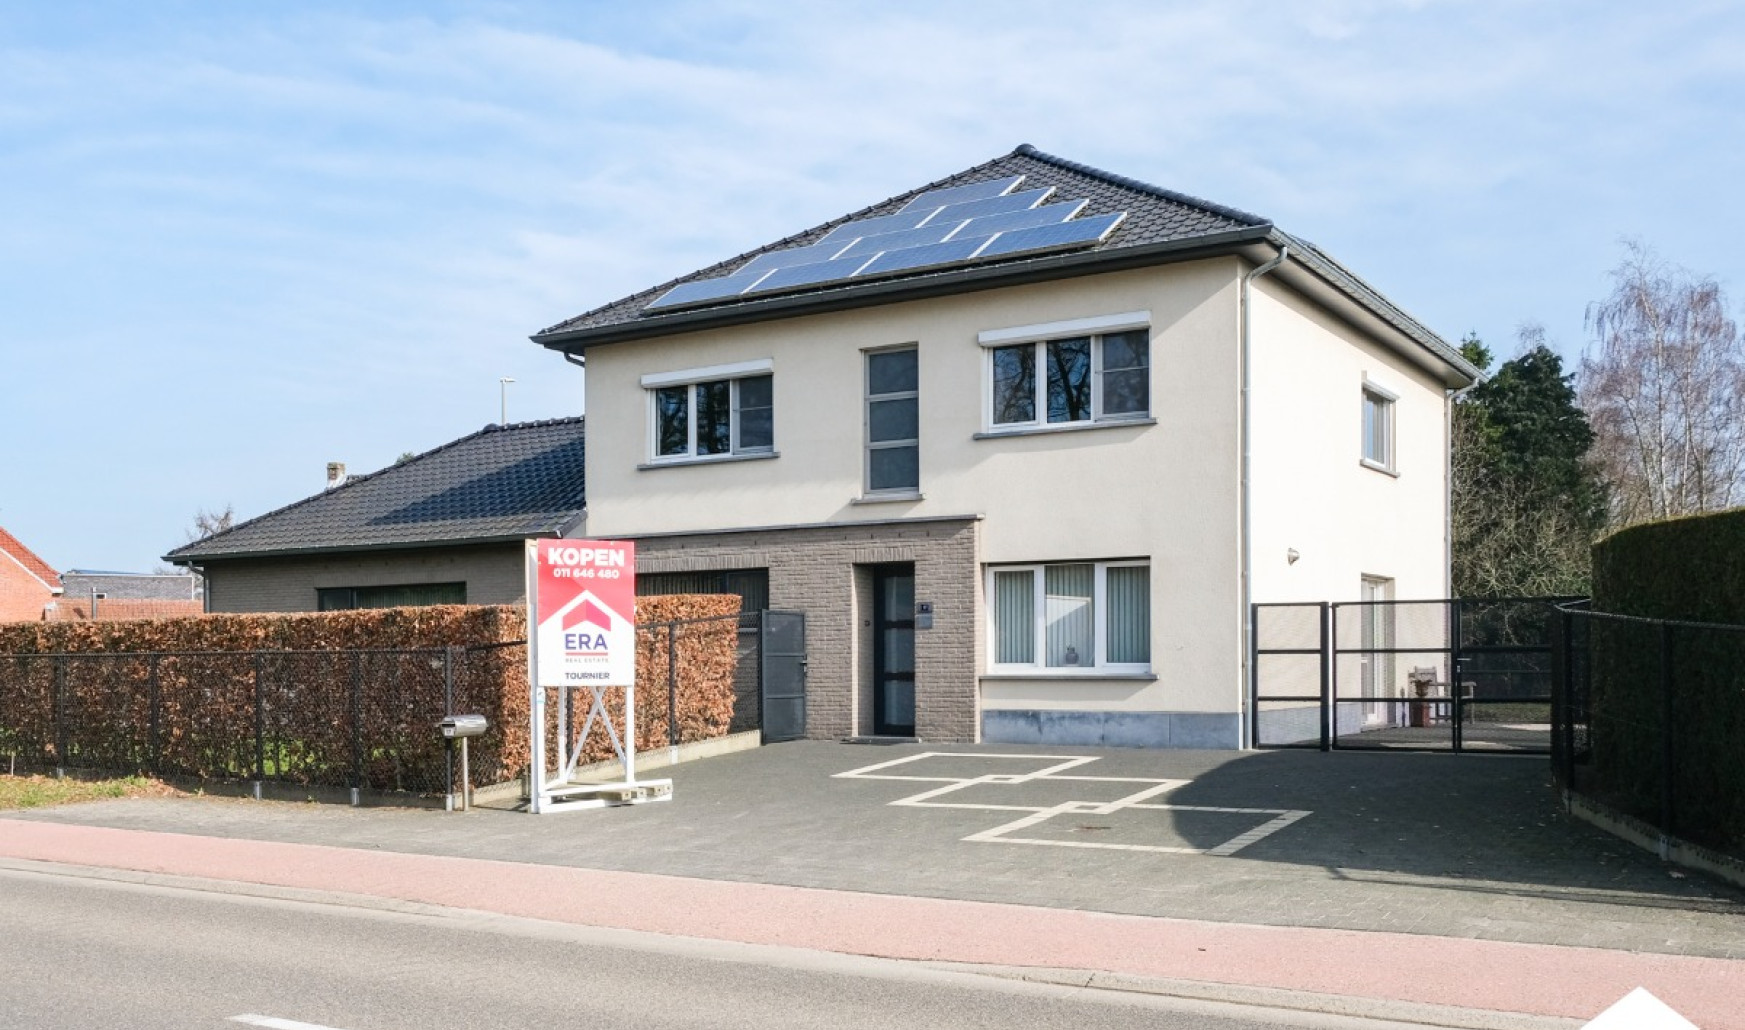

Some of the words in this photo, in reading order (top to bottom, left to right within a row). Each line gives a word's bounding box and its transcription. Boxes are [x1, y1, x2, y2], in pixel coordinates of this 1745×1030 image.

[547, 547, 625, 567] KOPEN
[553, 567, 571, 578] 011
[572, 569, 595, 578] 646
[597, 569, 620, 579] 480
[565, 633, 608, 650] ERA
[565, 672, 610, 680] TOURNIER
